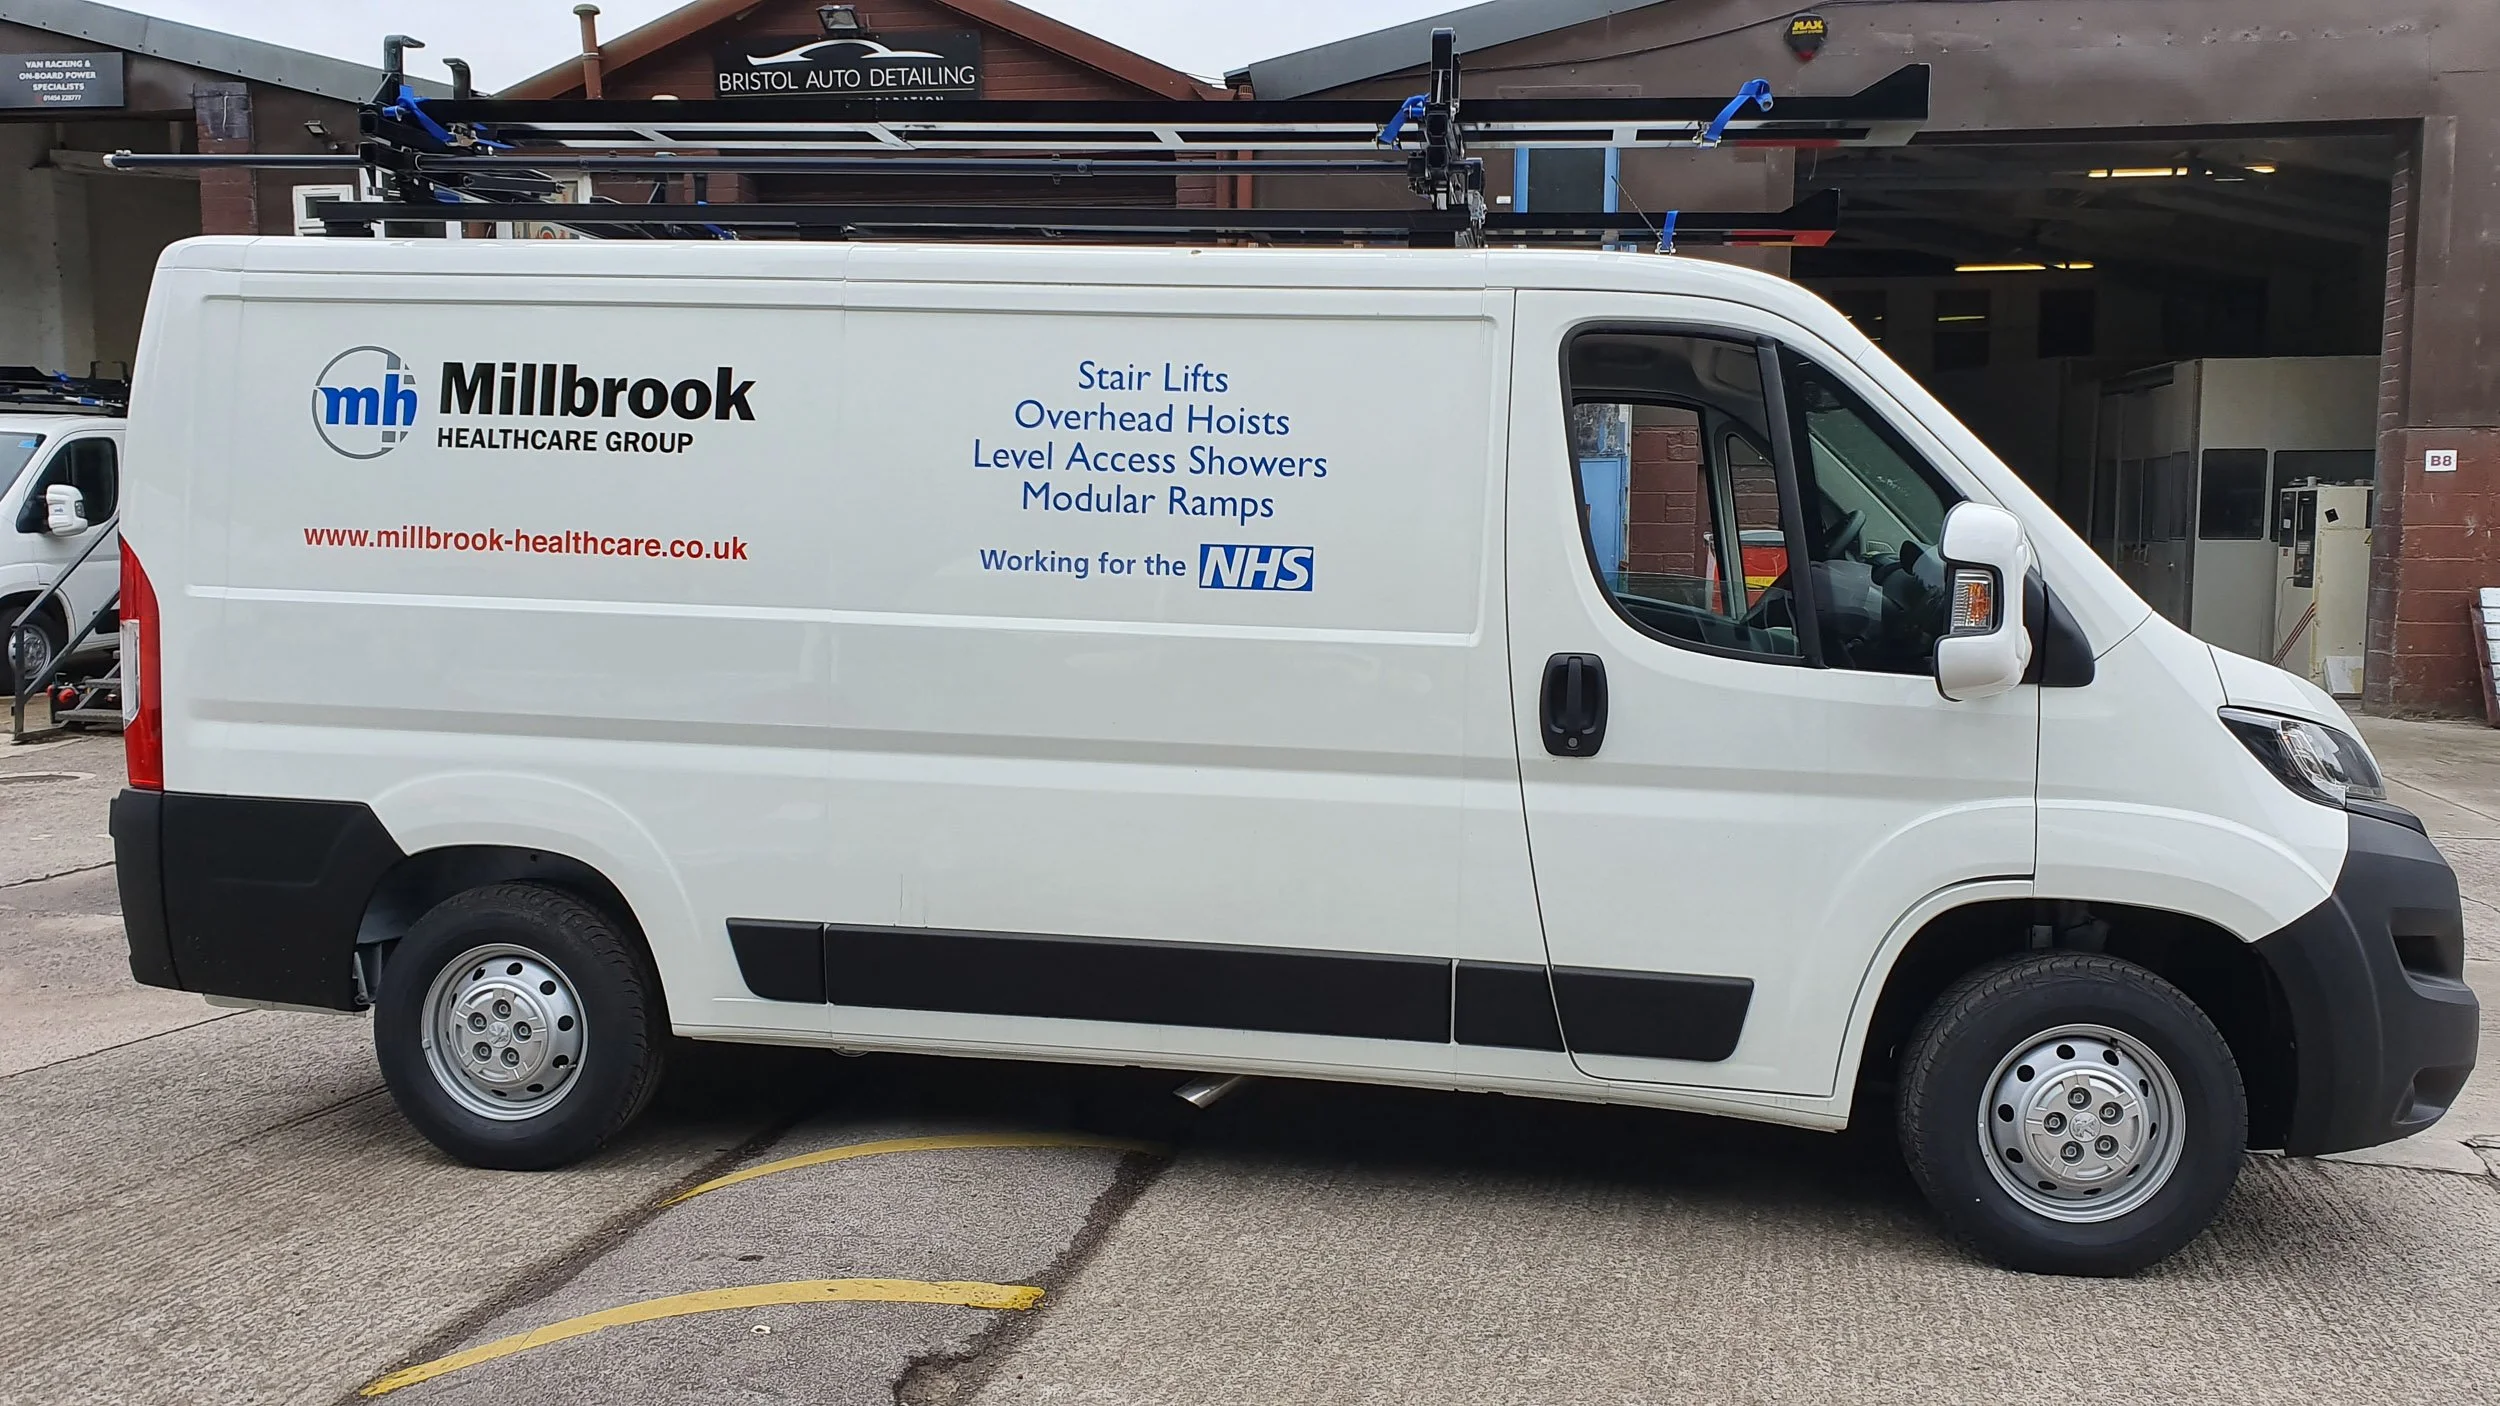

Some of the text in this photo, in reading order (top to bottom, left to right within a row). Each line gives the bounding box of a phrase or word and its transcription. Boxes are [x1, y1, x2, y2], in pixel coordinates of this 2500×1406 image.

[1792, 20, 1824, 31] MAX
[19, 71, 97, 80] ON-BOARD POWER
[25, 60, 91, 69] VAN RACKING &
[719, 66, 976, 92] BRISTOL AUTO DETAILING
[32, 82, 85, 91] SPECIALISTS
[439, 361, 757, 422] Millbrook
[1078, 360, 1229, 393] Stair Lifts
[317, 373, 418, 427] mh
[1014, 399, 1290, 436] Overhead Hoists
[437, 427, 694, 454] HEALTHCARE GROUP
[973, 438, 1328, 478] Level Access Showers
[2430, 455, 2452, 467] B8
[1022, 481, 1274, 527] Modular Ramps
[303, 525, 749, 561] www.millbrook-healthcare.co.uk
[979, 546, 1313, 590] Working for the NHS
